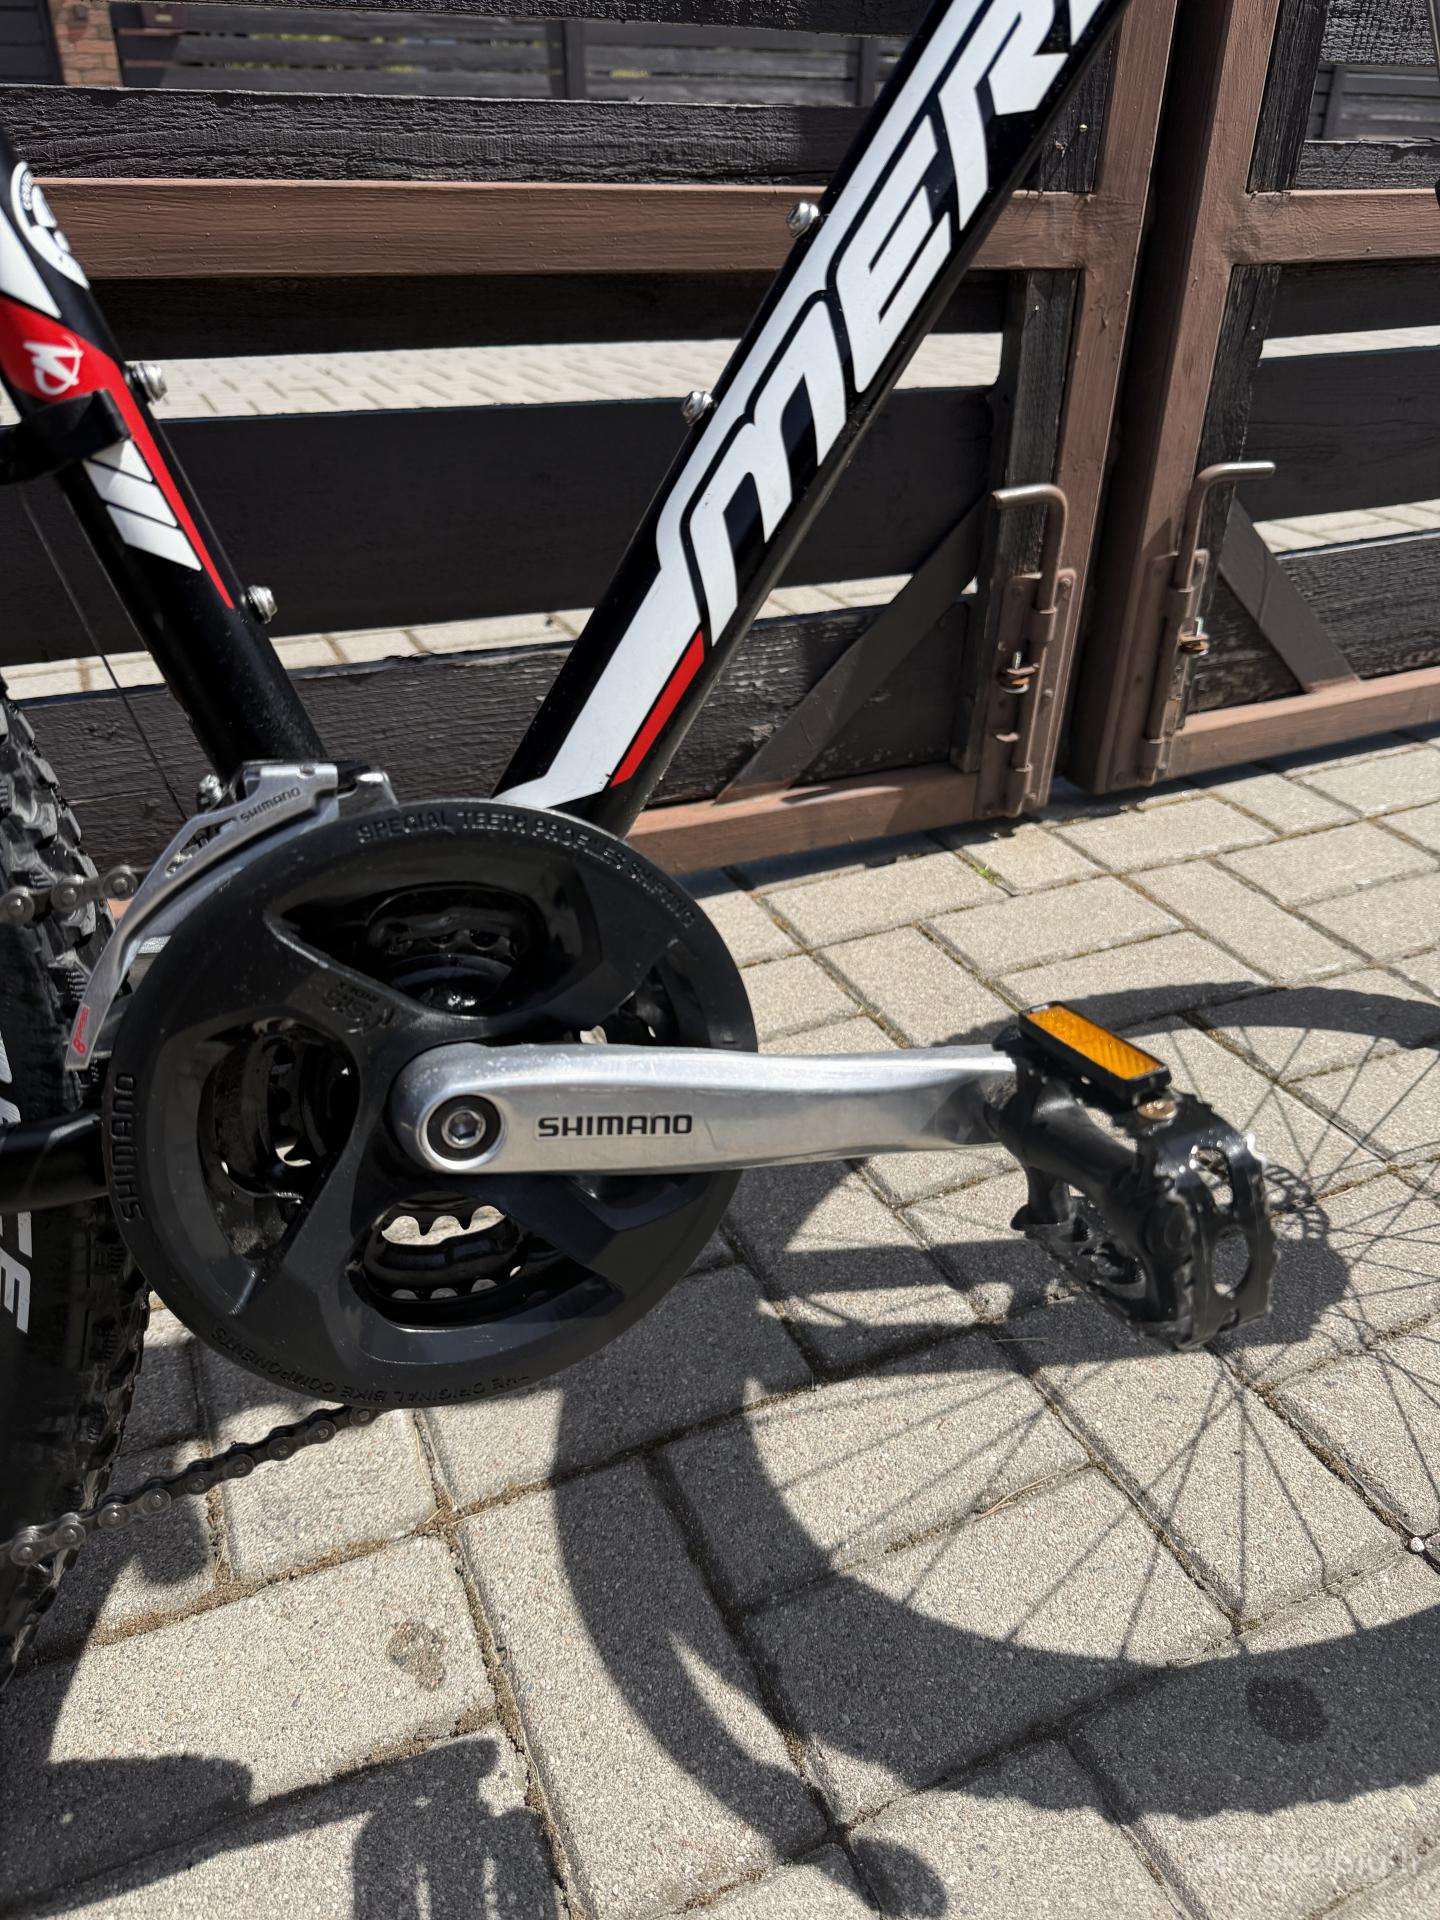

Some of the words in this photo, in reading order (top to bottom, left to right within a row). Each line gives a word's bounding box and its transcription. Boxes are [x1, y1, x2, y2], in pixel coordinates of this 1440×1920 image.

[689, 0, 1101, 648] MER
[240, 787, 300, 822] SHIMANO
[357, 810, 453, 843] SPECIAL
[456, 811, 528, 835] TEETH
[538, 1114, 692, 1137] SHIMANO
[111, 1072, 146, 1222] SHIMANO
